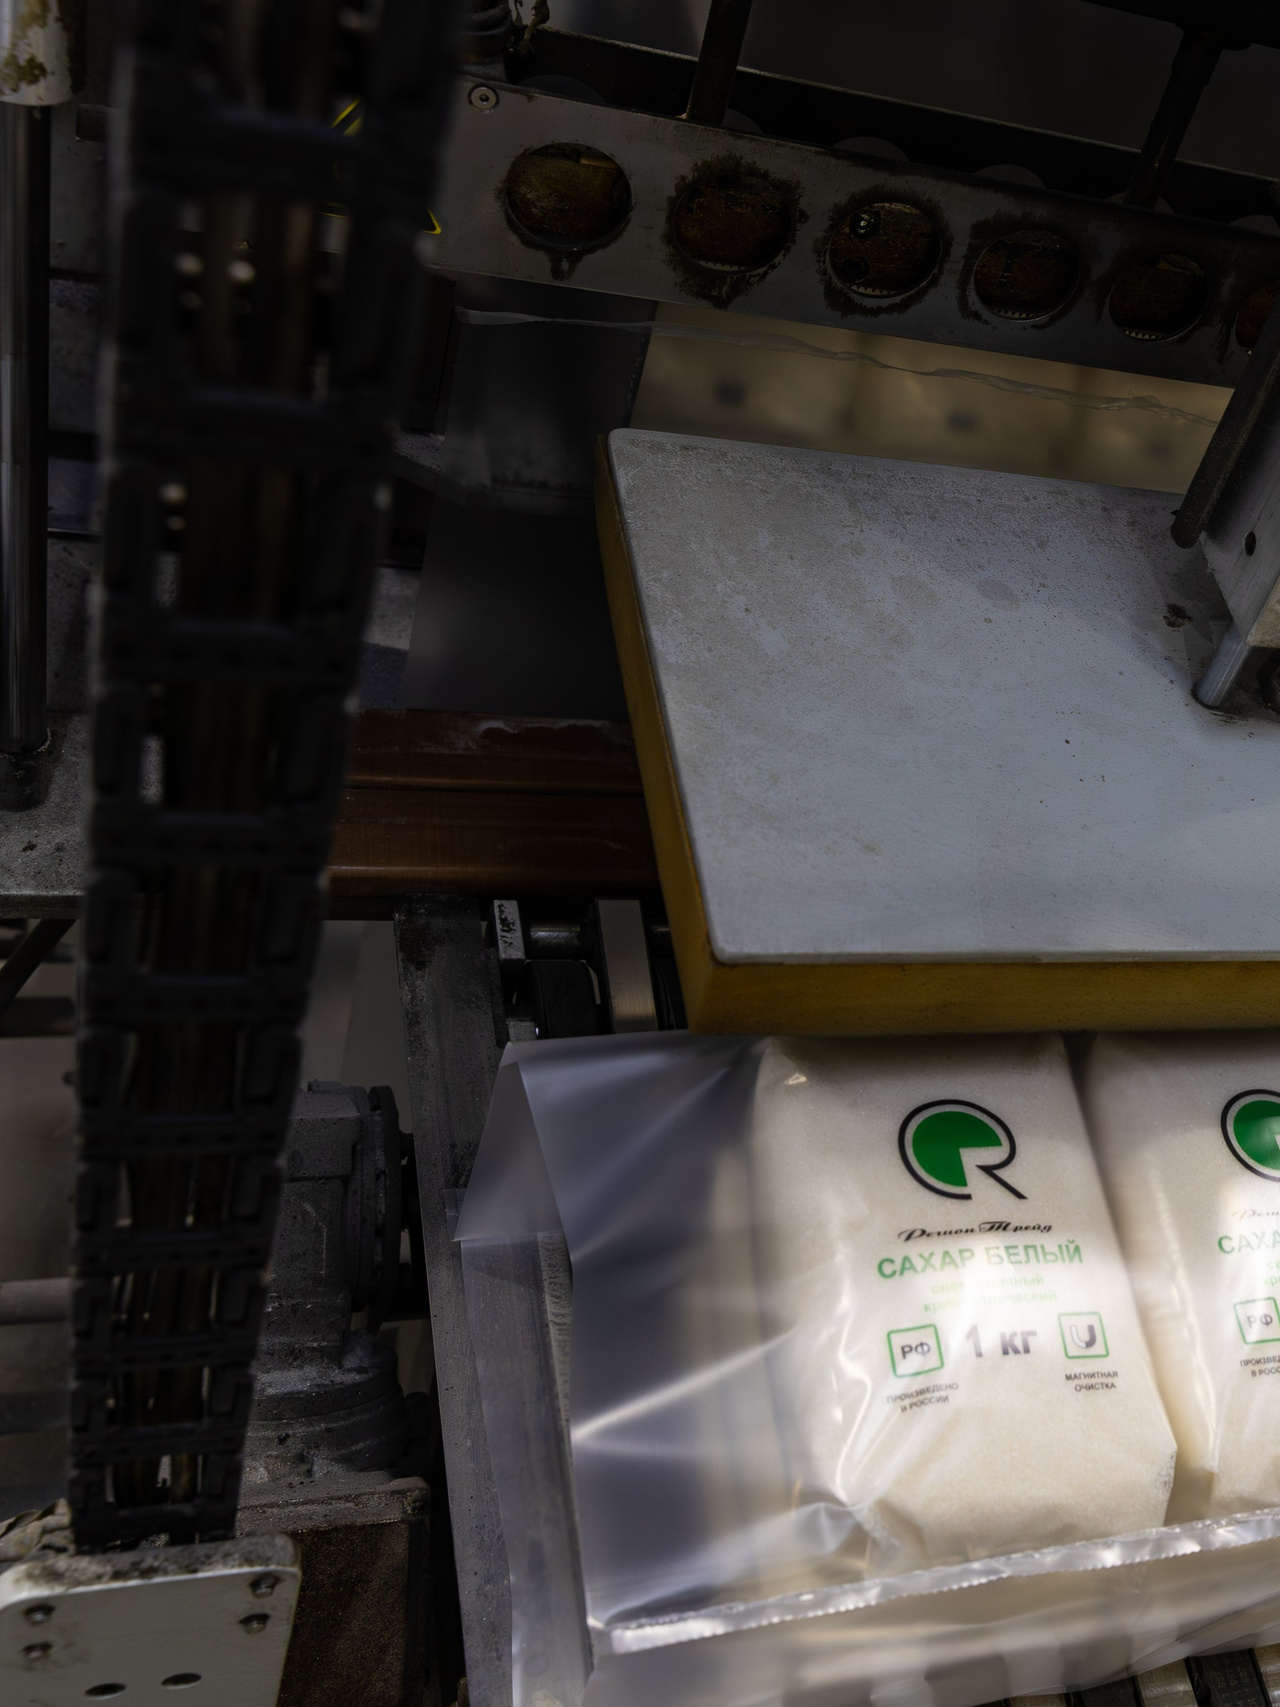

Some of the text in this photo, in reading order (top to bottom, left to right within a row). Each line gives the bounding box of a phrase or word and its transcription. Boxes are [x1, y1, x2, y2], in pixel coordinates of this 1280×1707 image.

[877, 1239, 1083, 1279] САХАР БЕЛЫЙ
[1247, 1312, 1273, 1328] РФ
[965, 1323, 983, 1358] 1
[901, 1341, 931, 1359] РФ
[1065, 1370, 1119, 1381] МАГНИТНАЯ
[886, 1382, 959, 1404] ПРОИЗВЕДЕНО
[1074, 1382, 1117, 1392] ОЧИСТКА
[909, 1395, 949, 1410] РОССИИ
